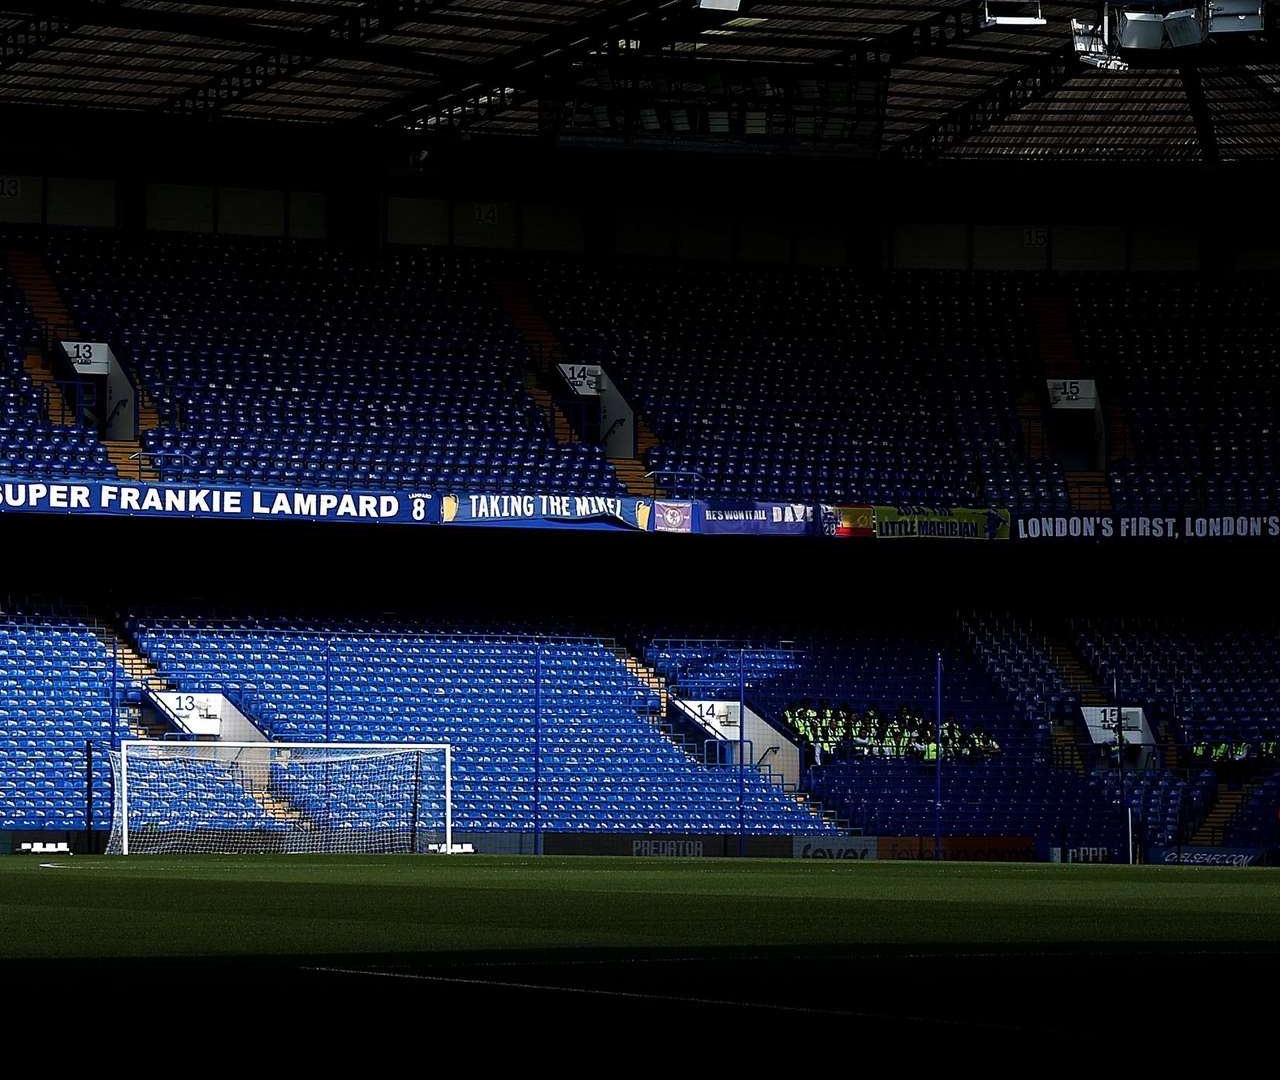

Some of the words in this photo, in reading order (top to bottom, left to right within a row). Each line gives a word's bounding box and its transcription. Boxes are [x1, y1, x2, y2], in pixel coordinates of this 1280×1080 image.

[73, 344, 93, 359] 13
[569, 366, 587, 381] 14
[1061, 382, 1080, 395] 15
[100, 485, 242, 513] FRANKIE
[252, 491, 400, 519] LAMPARD
[412, 498, 425, 520] 8
[469, 495, 534, 518] TAKING
[539, 495, 571, 518] THE
[754, 510, 767, 520] ALL
[824, 523, 836, 536] 28
[880, 520, 917, 537] LITTLE
[919, 520, 978, 537] MAGICIAN
[1018, 516, 1114, 539] LONDON'S
[1120, 516, 1179, 540] FIRST,
[1185, 515, 1280, 537] LONDON'S
[176, 696, 195, 710] 13
[697, 704, 715, 718] 14
[1100, 709, 1118, 723] 15
[632, 839, 704, 857] PREDATOR
[803, 843, 868, 859] fever
